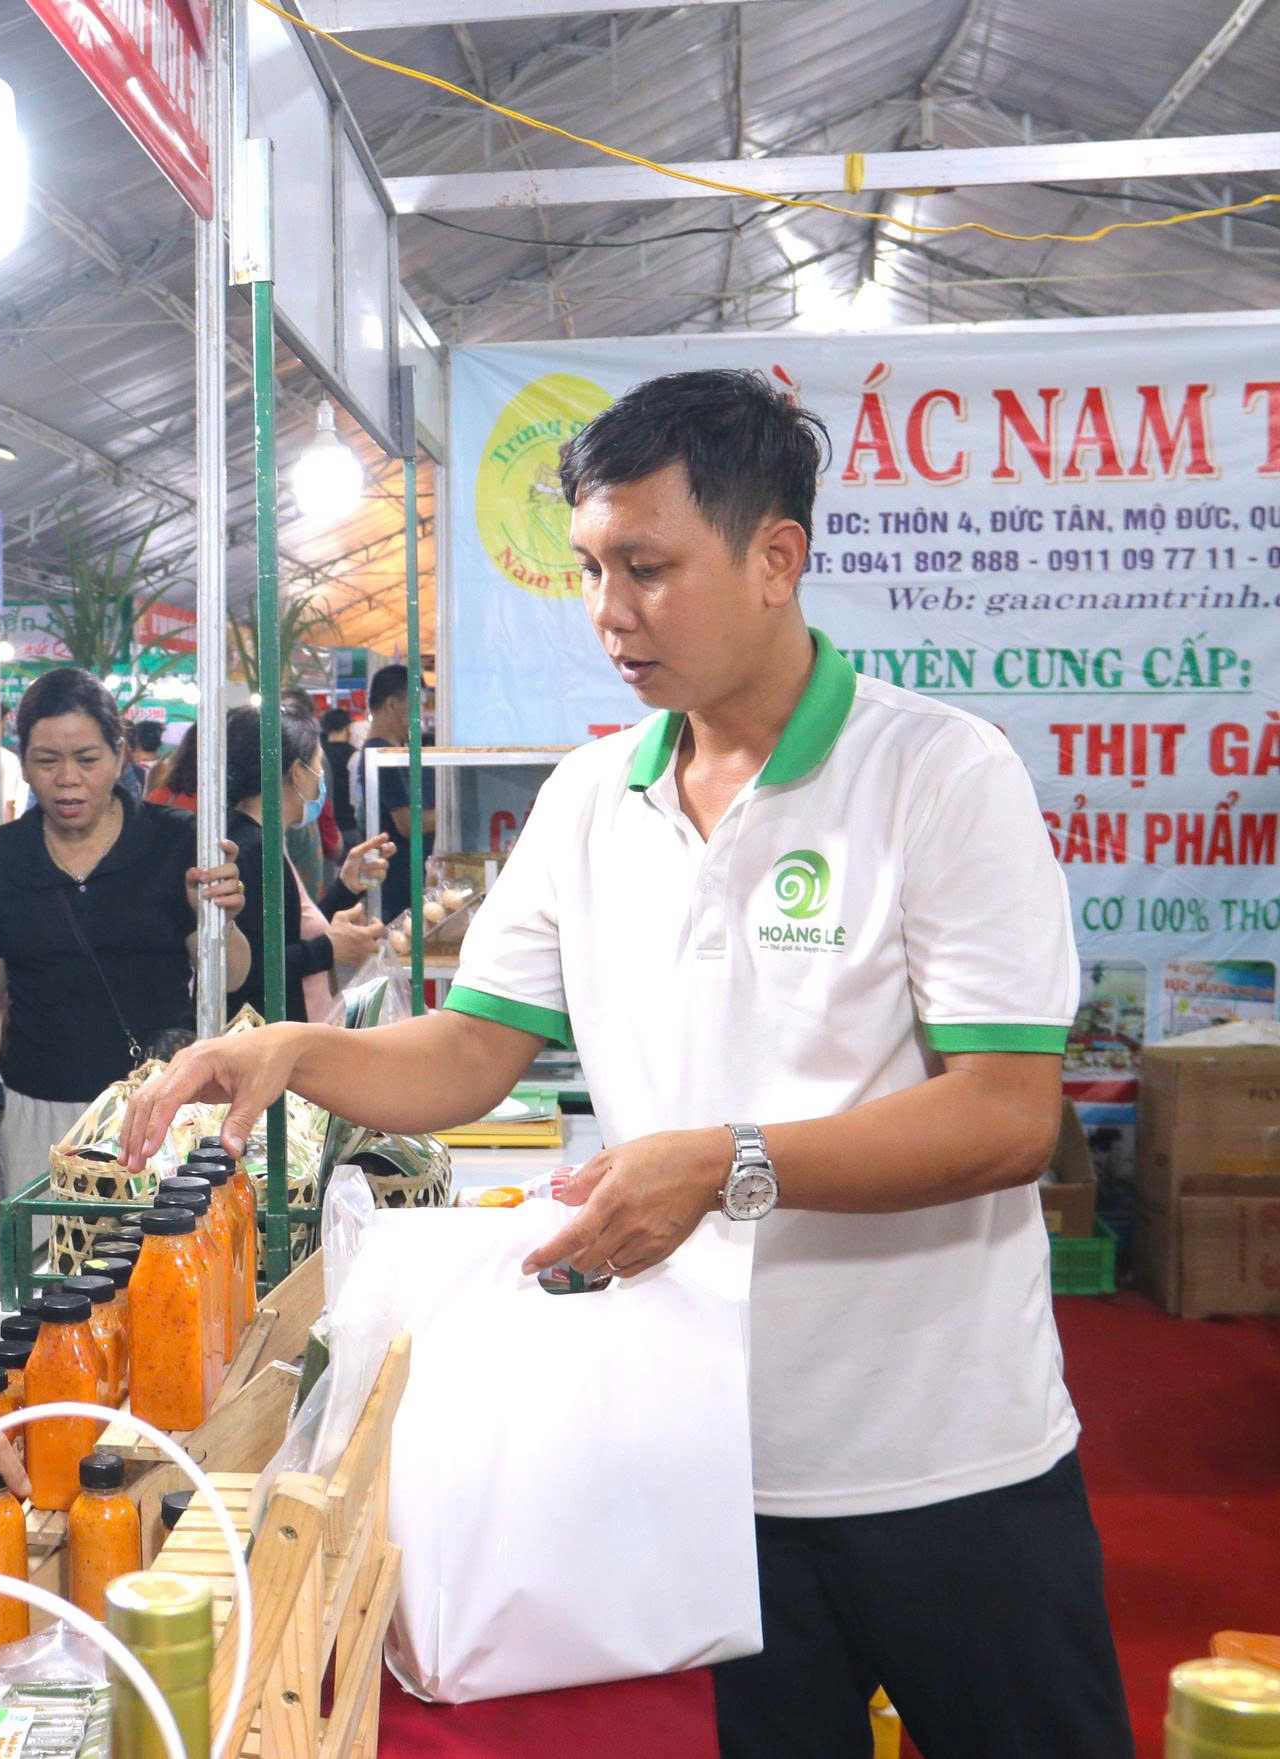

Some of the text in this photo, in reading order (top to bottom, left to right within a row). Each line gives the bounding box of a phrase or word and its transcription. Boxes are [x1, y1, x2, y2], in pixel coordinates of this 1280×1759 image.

[841, 362, 966, 482] ÁC
[991, 382, 1217, 482] NAM
[826, 511, 870, 535] ĐC:
[878, 507, 948, 535] THÔN
[957, 511, 981, 535] 4,
[990, 505, 1044, 533] ĐỨC
[1053, 504, 1113, 533] TÂN,
[1123, 502, 1166, 536] MỘ
[1176, 502, 1239, 532] ĐỨC,
[495, 545, 551, 591] Nam
[841, 552, 902, 574] 0941
[914, 550, 962, 573] 802
[972, 550, 1019, 573] 888
[1048, 549, 1109, 572] 0911
[1122, 548, 1154, 571] 09
[1163, 547, 1196, 570] 77
[1206, 546, 1236, 569] 11
[888, 587, 976, 611] Web:
[838, 630, 1252, 689] UYÊN CUNG CẤP:
[1049, 723, 1186, 788] THỊT
[1043, 790, 1278, 866] SẢN PHẨM
[758, 923, 846, 946] HOÀNG LÊ
[1082, 896, 1124, 932] CƠ
[1137, 897, 1210, 933] 100%
